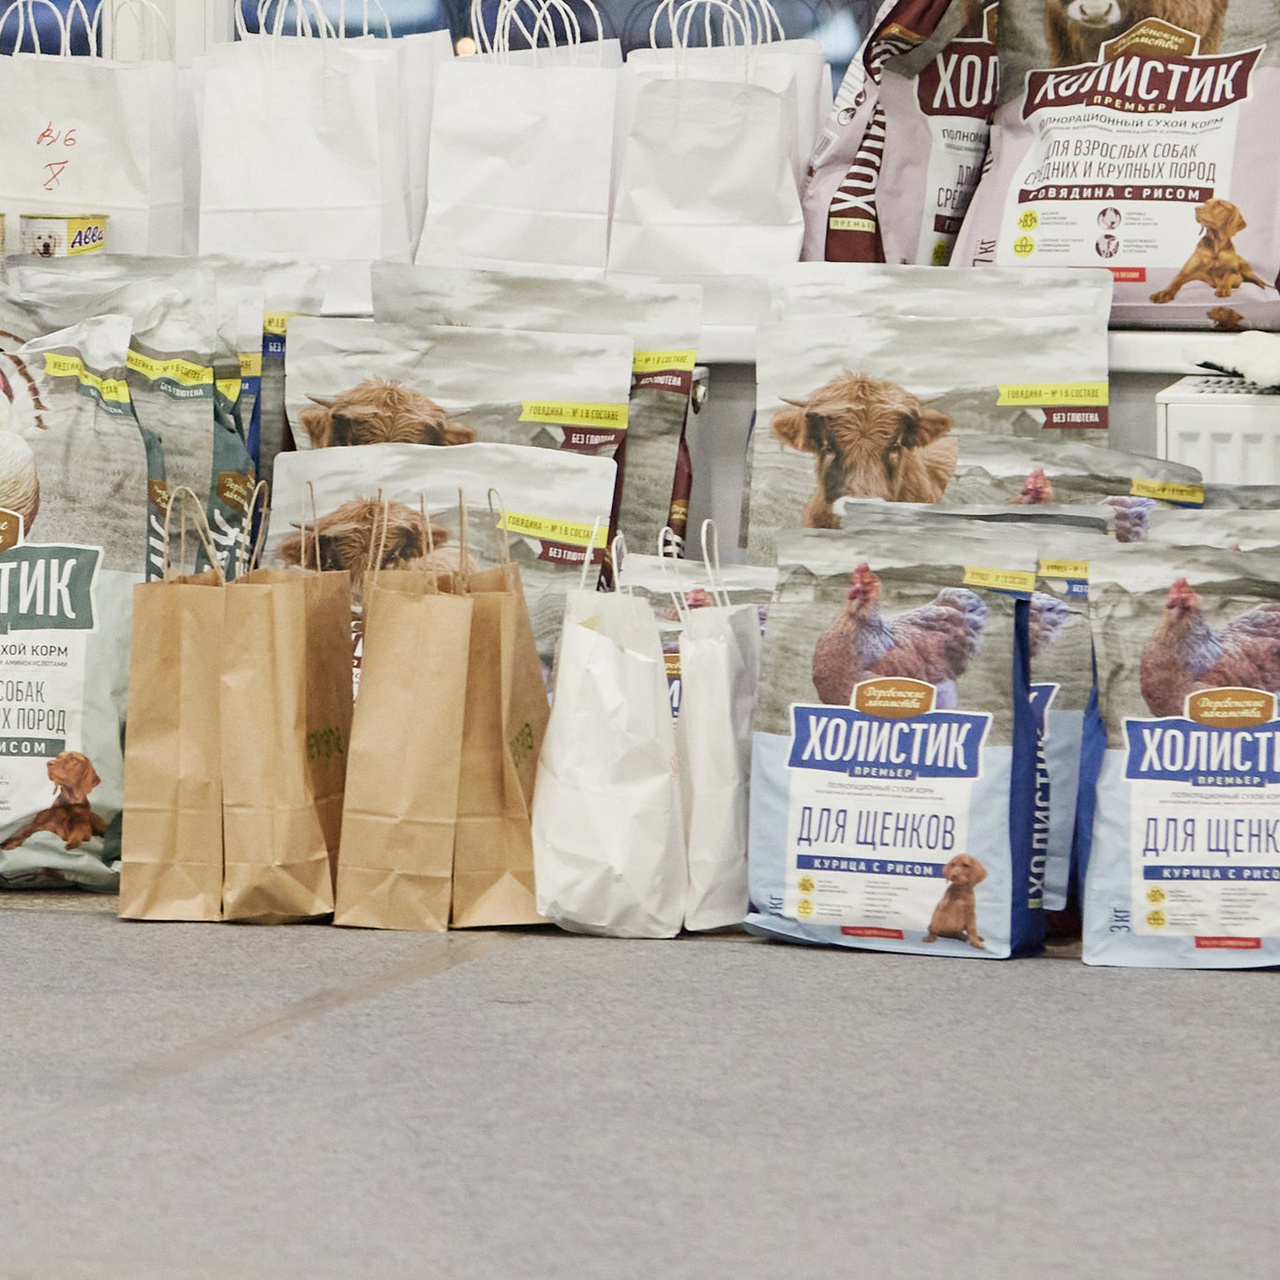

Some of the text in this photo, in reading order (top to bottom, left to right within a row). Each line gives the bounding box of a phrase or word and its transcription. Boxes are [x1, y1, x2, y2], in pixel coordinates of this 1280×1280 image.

[1033, 56, 1243, 105] ХОЛИСТИК
[1093, 95, 1167, 112] ПРЕМЬЕР
[1147, 118, 1187, 128] СУХОЙ
[1074, 140, 1149, 160] ВЗРОСЛЫХ
[1153, 143, 1199, 159] СОБАК
[1083, 161, 1216, 183] И КРУПНЫХ ПОРОД
[1029, 187, 1200, 200] ГОВЯДИНА С РИСОМ
[1052, 412, 1100, 423] БЕЗ ГЛЮТЕНА
[571, 433, 584, 443] БЕЗ
[548, 547, 561, 558] БЕЗ
[31, 645, 68, 657] КОРМ
[17, 709, 66, 735] ПОРОД
[802, 715, 972, 770] ХОЛИСТИК
[1140, 728, 1280, 772] ХОЛИСТ
[854, 767, 913, 778] ПРЕМЬЕР
[1198, 775, 1262, 786] ПРЕМЬЕР
[798, 806, 955, 851] ДЛЯ ЩЕНКОВ
[1142, 817, 1280, 858] ДЛЯ ЩЕНК
[813, 859, 933, 875] КУРИЦА С РИСОМ
[1163, 869, 1280, 880] КУРИЦА С РИСО
